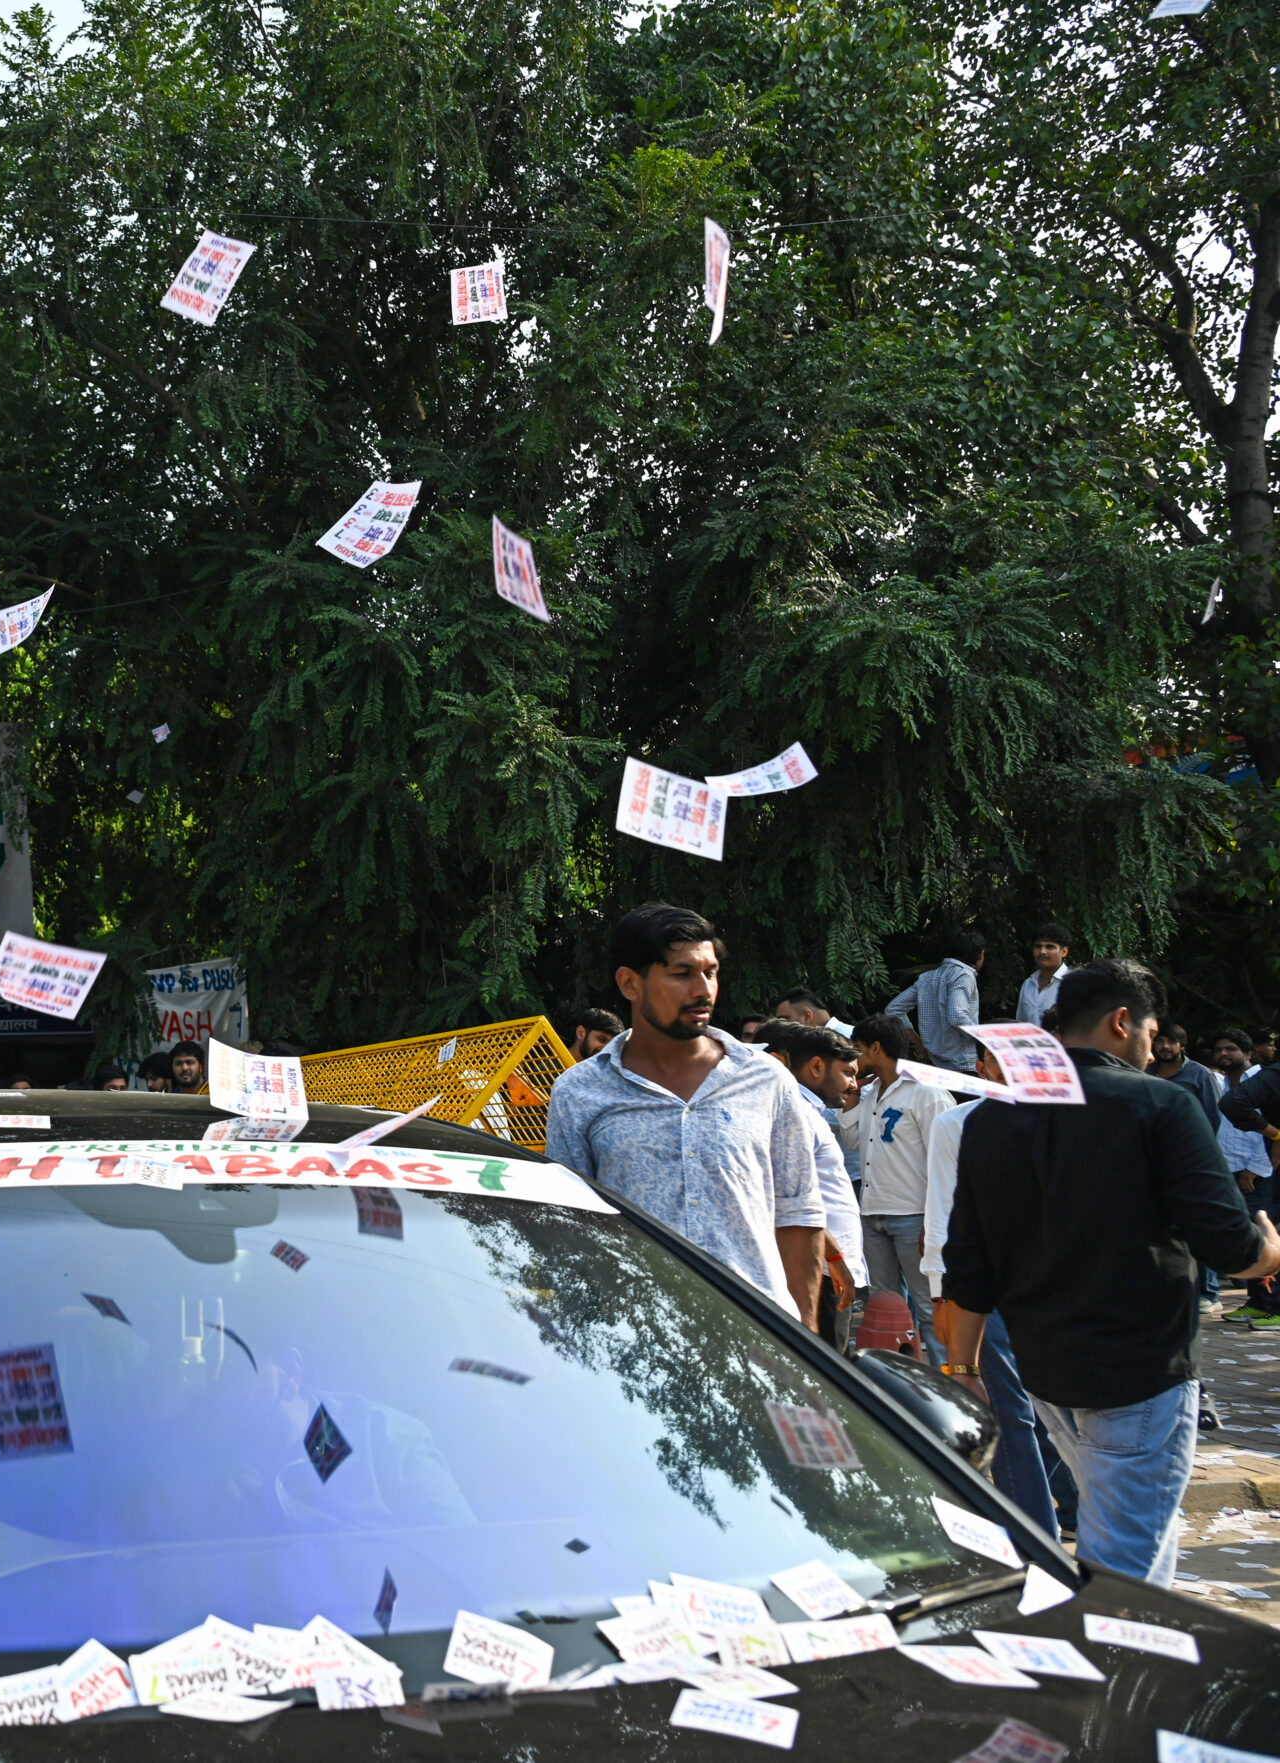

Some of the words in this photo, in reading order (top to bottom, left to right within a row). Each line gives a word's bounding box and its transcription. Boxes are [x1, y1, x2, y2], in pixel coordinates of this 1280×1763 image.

[202, 968, 235, 991] DUSU
[158, 1010, 214, 1043] YASH
[237, 1104, 249, 1113] 3
[256, 1106, 270, 1114] 3
[880, 1106, 904, 1143] 7
[40, 1142, 310, 1156] PRESIDENT
[433, 1153, 510, 1191] 7
[463, 1632, 517, 1662] YASH
[674, 1634, 696, 1655] 7
[105, 1667, 130, 1688] 7
